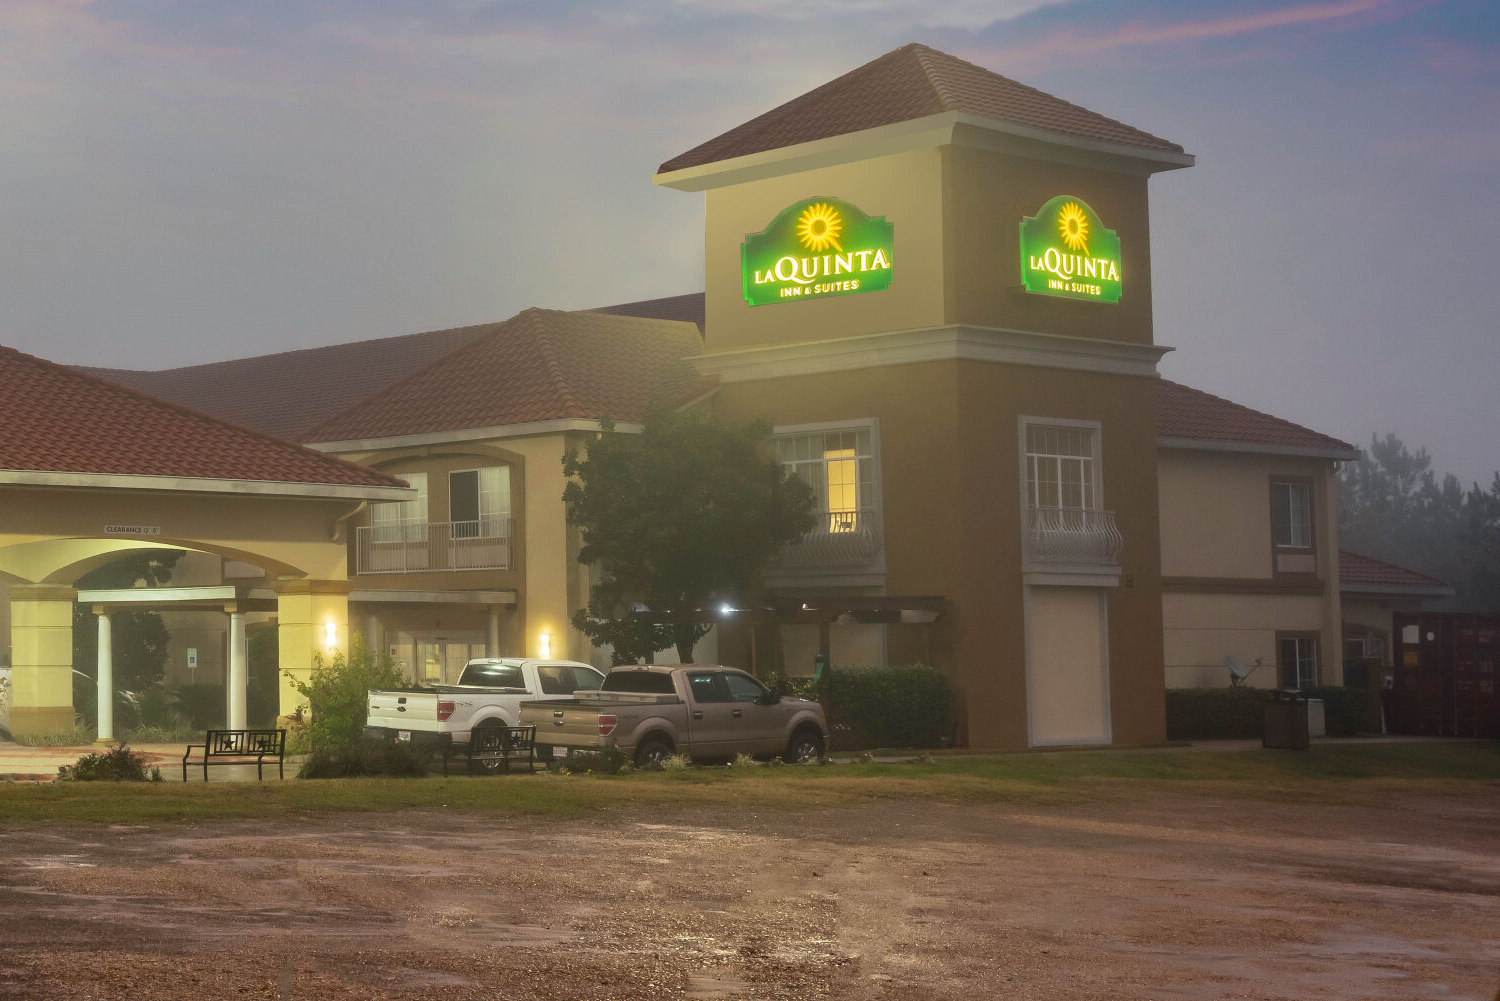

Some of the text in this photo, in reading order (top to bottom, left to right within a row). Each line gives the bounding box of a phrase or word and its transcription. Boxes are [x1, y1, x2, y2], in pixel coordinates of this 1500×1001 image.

[780, 279, 860, 297] INN & SUITES
[1048, 279, 1063, 290] INN
[1071, 283, 1101, 296] SUITES
[106, 526, 142, 534] CLEARANCE
